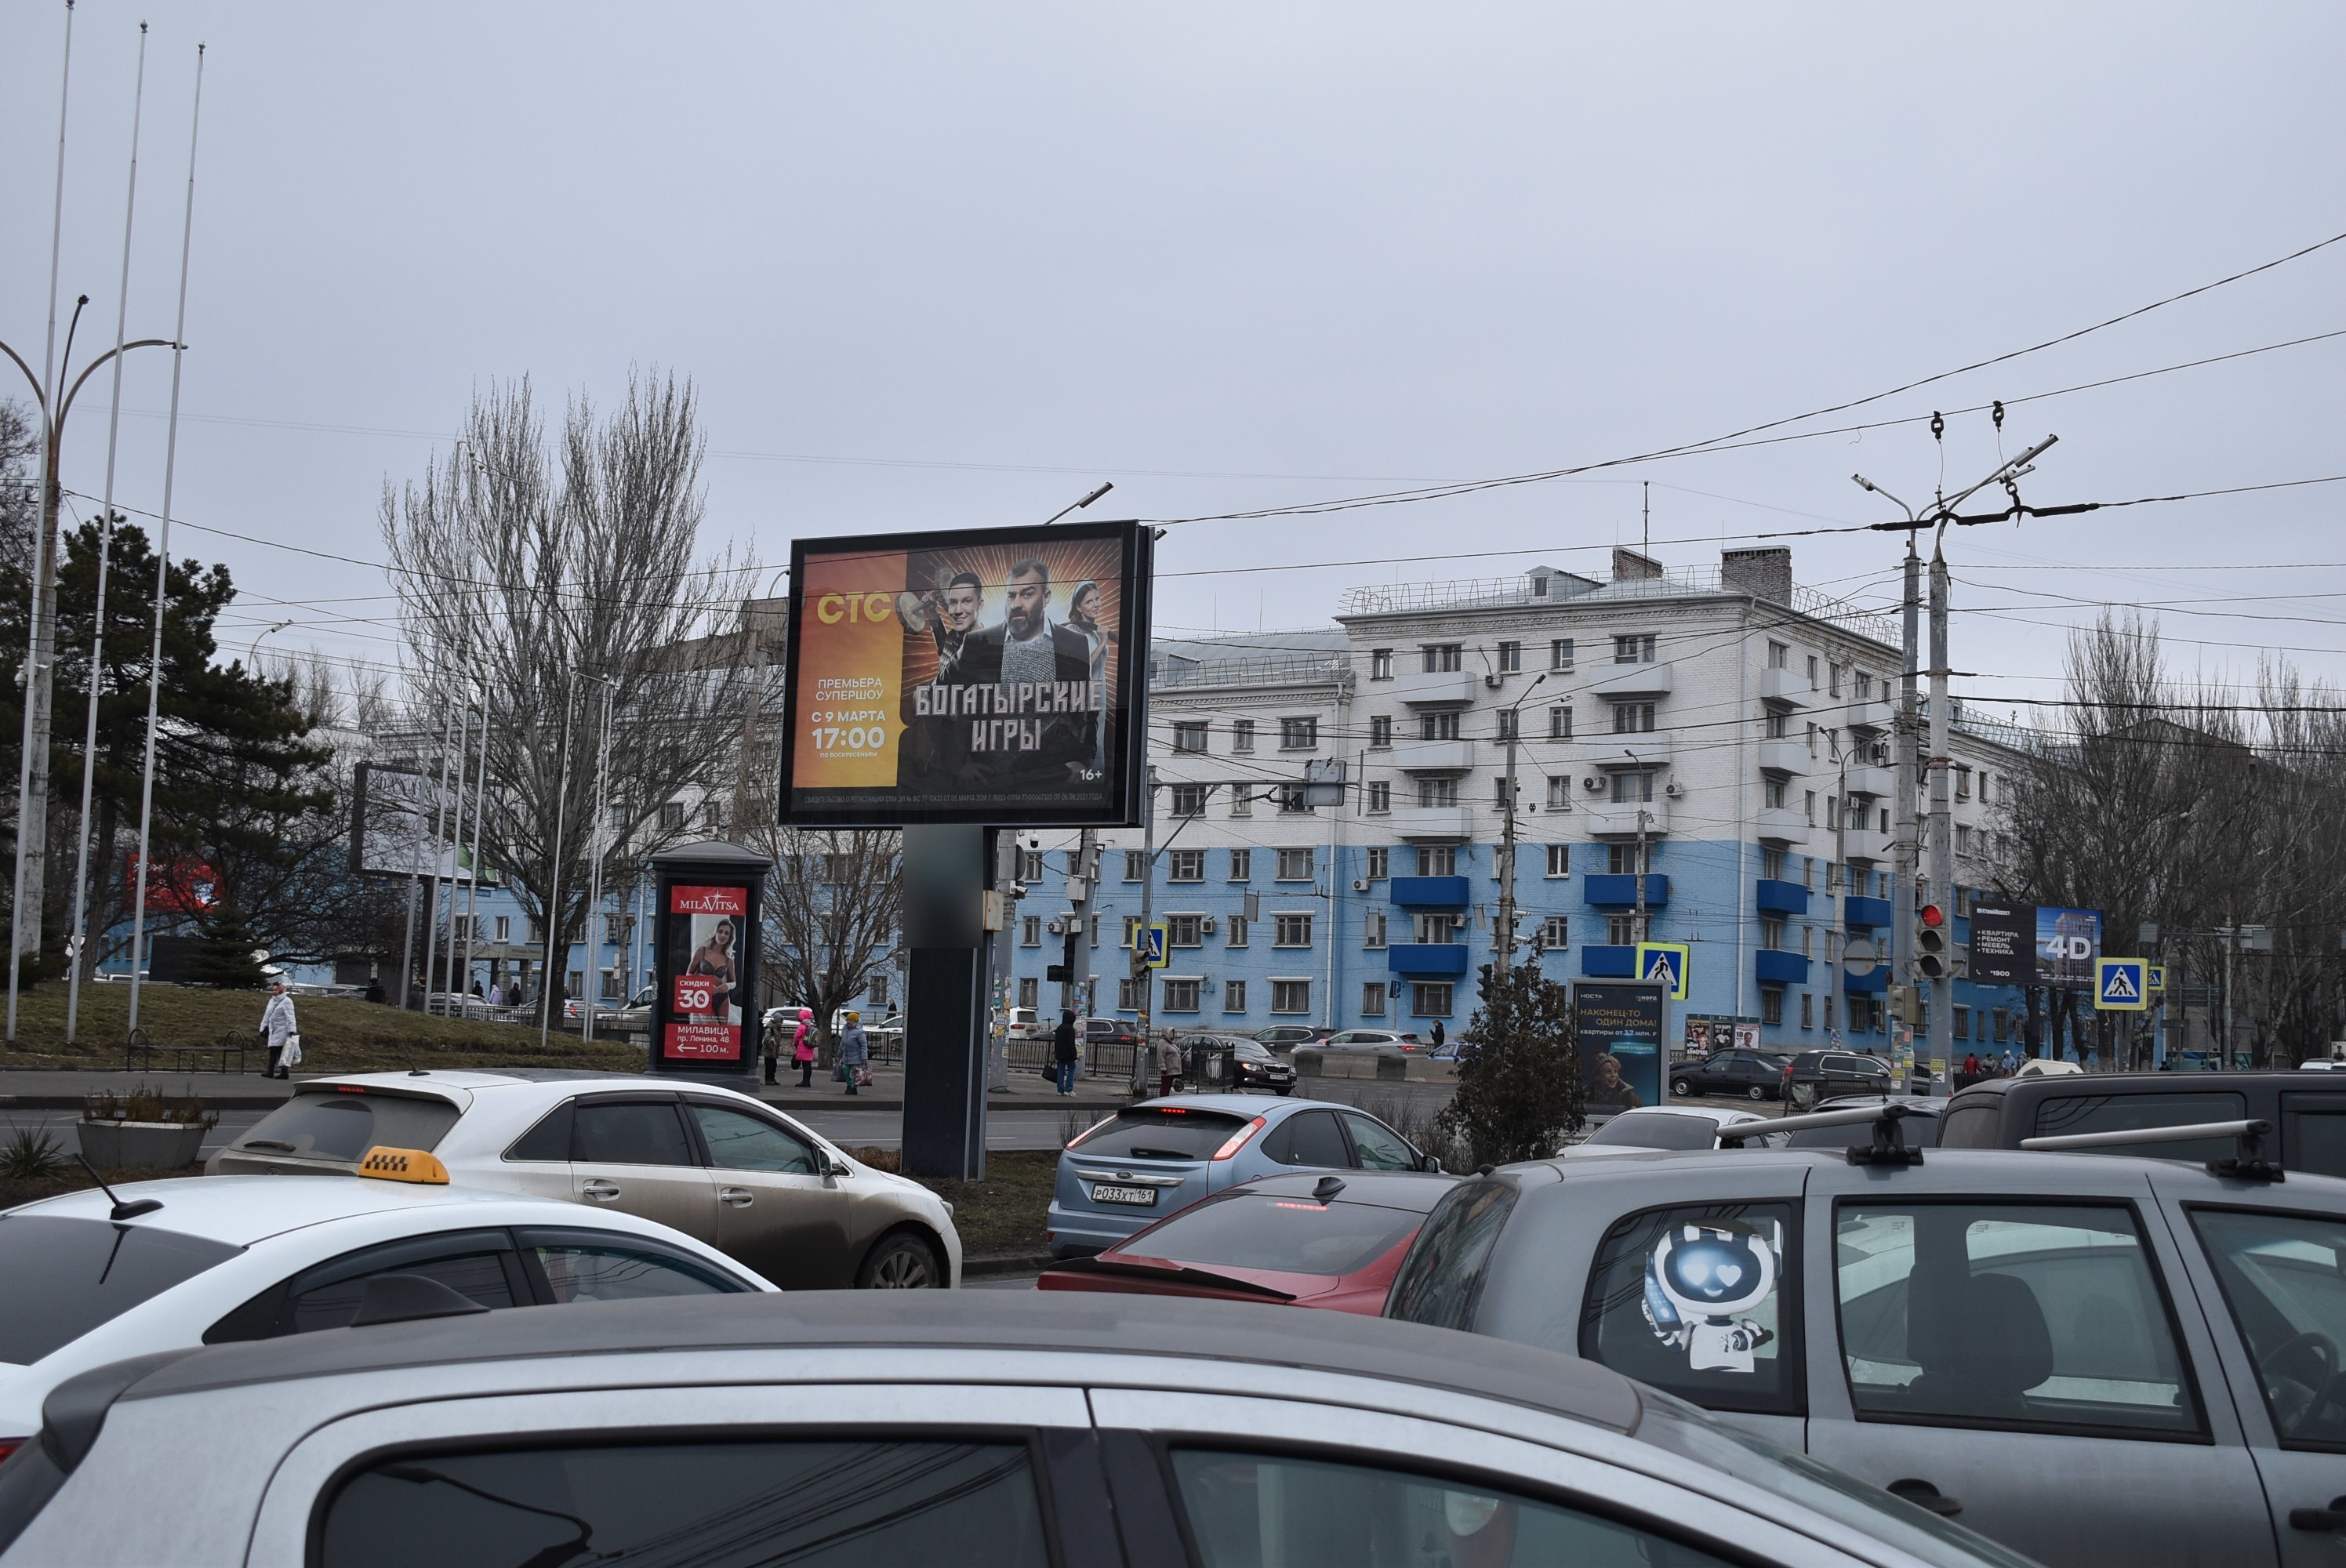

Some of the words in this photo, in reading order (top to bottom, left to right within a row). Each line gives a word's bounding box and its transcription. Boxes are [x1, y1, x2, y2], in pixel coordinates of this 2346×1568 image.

[817, 590, 892, 624] СТС
[818, 678, 882, 689] ПРЕМЬЕРА
[816, 690, 883, 701] СУПЕРШОУ
[915, 680, 1102, 716] БОГАТЫРСКИЕ
[811, 711, 822, 722] С
[825, 711, 834, 722] 9
[838, 710, 886, 722] МАРТА
[812, 726, 885, 749] 17:00
[971, 718, 1041, 753] ИГРЫ
[1080, 768, 1102, 781] 16+
[680, 896, 740, 912] MILAVITSA
[2045, 935, 2092, 960] 4D
[1580, 1008, 1641, 1017] НАКОНЕЦ-ТО
[1596, 1018, 1623, 1026] ОДИН
[678, 1026, 729, 1036] МИЛАВИЦА
[700, 1045, 719, 1053] 100
[1137, 1190, 1152, 1199] 161
